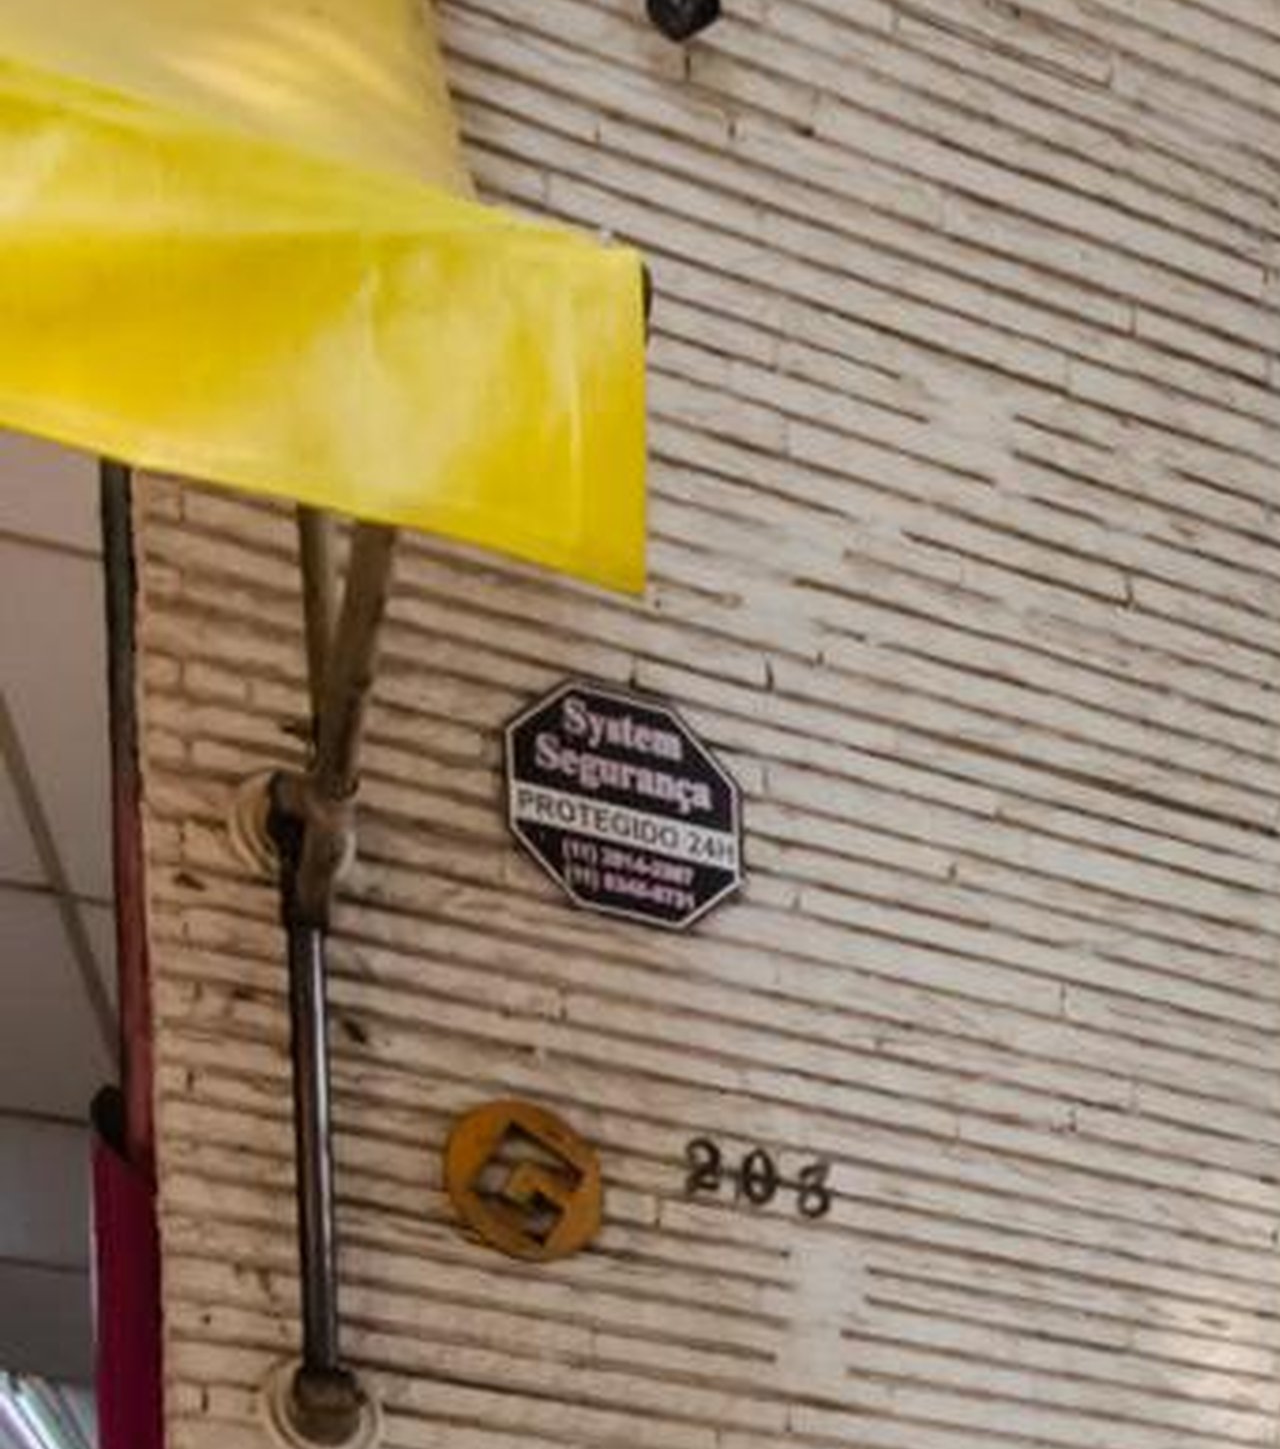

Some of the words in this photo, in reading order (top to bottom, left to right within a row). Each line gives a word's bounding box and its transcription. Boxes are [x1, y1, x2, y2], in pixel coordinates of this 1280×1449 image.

[562, 697, 683, 760] System
[535, 733, 712, 813] Segurança
[517, 789, 679, 848] PROTEGIDO
